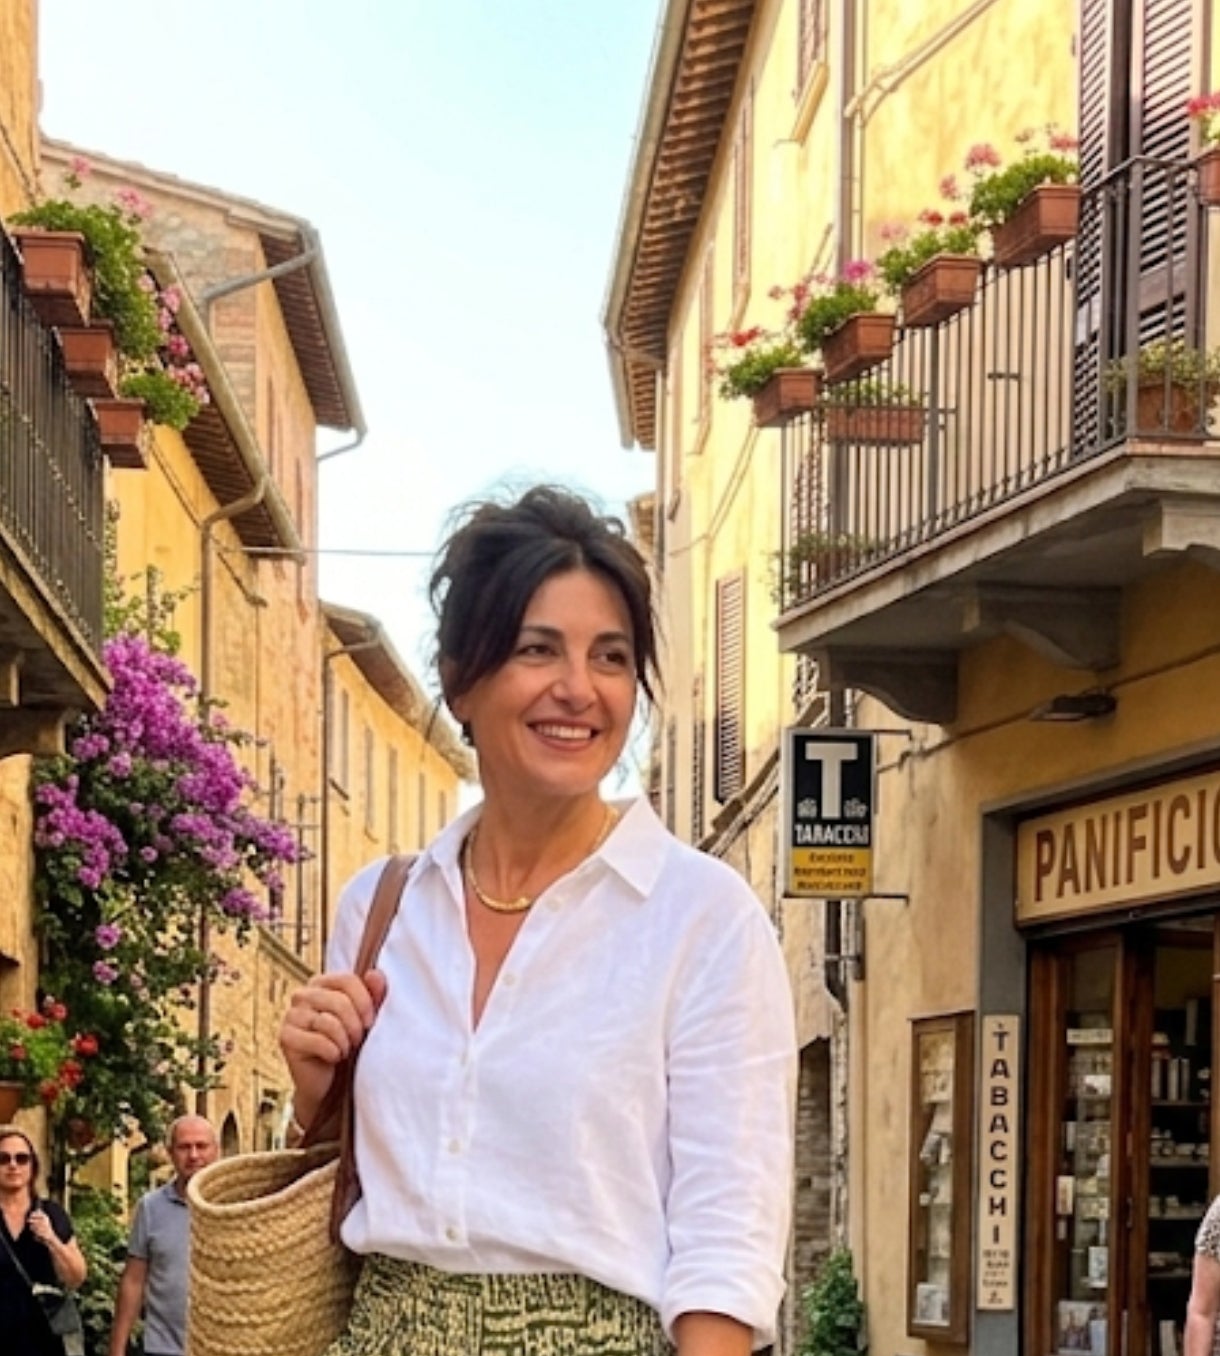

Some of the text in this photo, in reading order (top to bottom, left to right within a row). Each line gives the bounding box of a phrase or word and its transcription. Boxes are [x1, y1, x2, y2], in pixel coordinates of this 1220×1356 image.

[805, 742, 858, 819] T
[1034, 788, 1220, 902] PANIFICI
[988, 1030, 1011, 1245] TABACCHI
